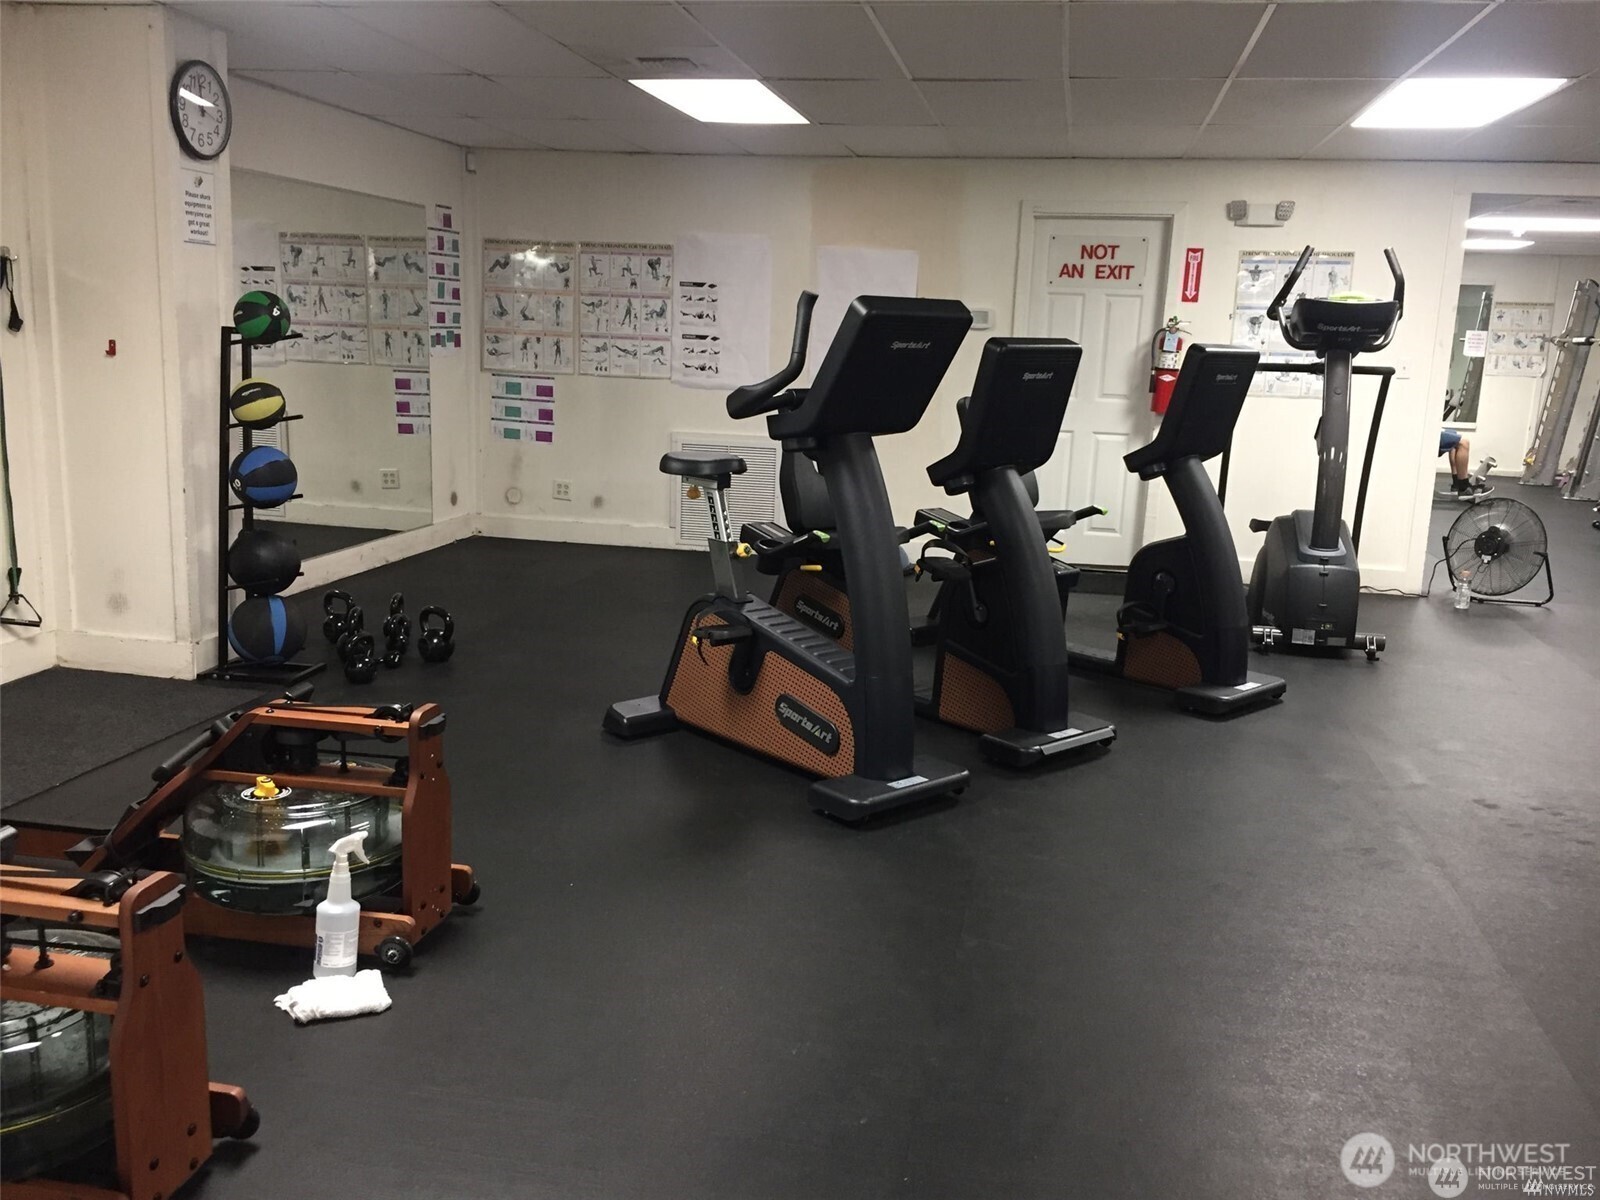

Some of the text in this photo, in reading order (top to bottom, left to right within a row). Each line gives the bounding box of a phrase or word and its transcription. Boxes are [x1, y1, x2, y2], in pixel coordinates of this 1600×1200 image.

[179, 97, 186, 111] 9
[213, 93, 220, 107] 2
[182, 114, 189, 128] 8
[216, 110, 223, 123] 3
[190, 127, 196, 141] 7
[213, 124, 220, 137] 4
[198, 133, 205, 147] 6
[207, 132, 213, 146] 5
[1080, 244, 1120, 260] NOT
[1059, 263, 1135, 281] AN EXIT
[1317, 323, 1361, 333] SportsArt
[890, 340, 931, 350] SportsArt
[1022, 371, 1054, 382] SportsArt
[796, 599, 840, 631] SportsArt
[777, 702, 833, 744] SportsArt
